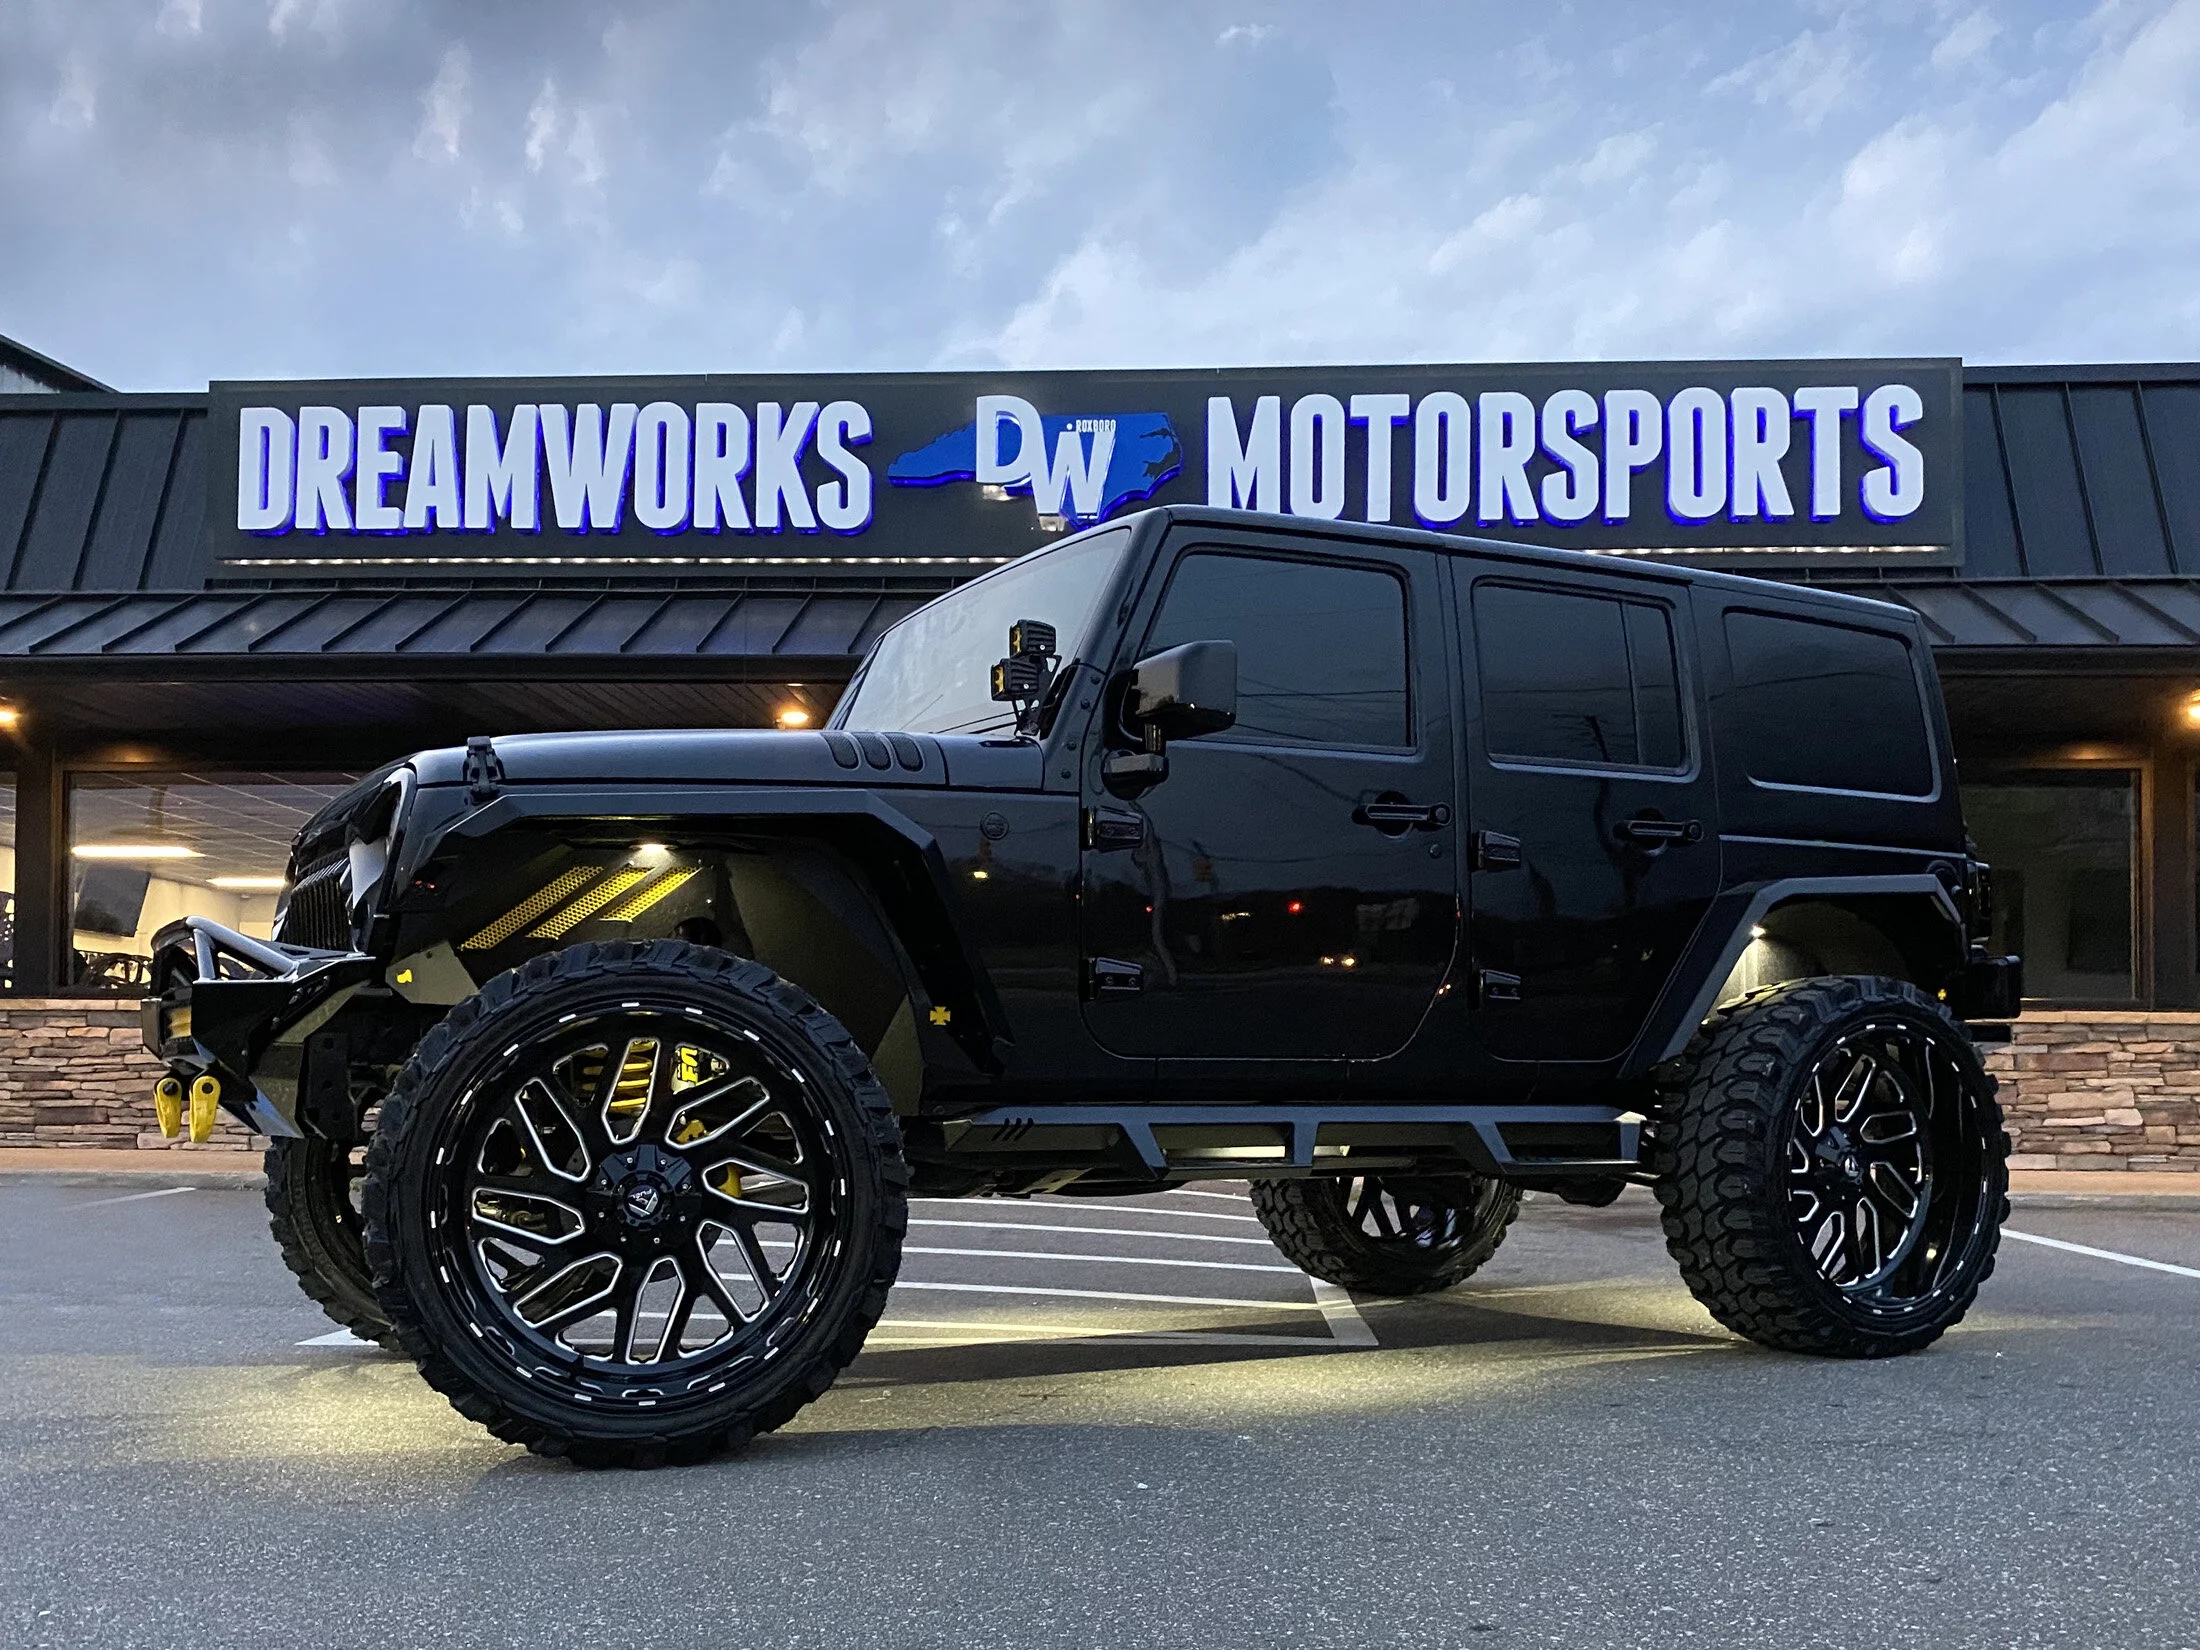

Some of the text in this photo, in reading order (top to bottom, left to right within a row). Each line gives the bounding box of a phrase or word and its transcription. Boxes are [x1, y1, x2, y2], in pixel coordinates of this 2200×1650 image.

[238, 385, 1924, 534] DREAMWORKS MOTORSPORTS
[976, 395, 1116, 516] DW
[1075, 419, 1116, 432] ROXBORO
